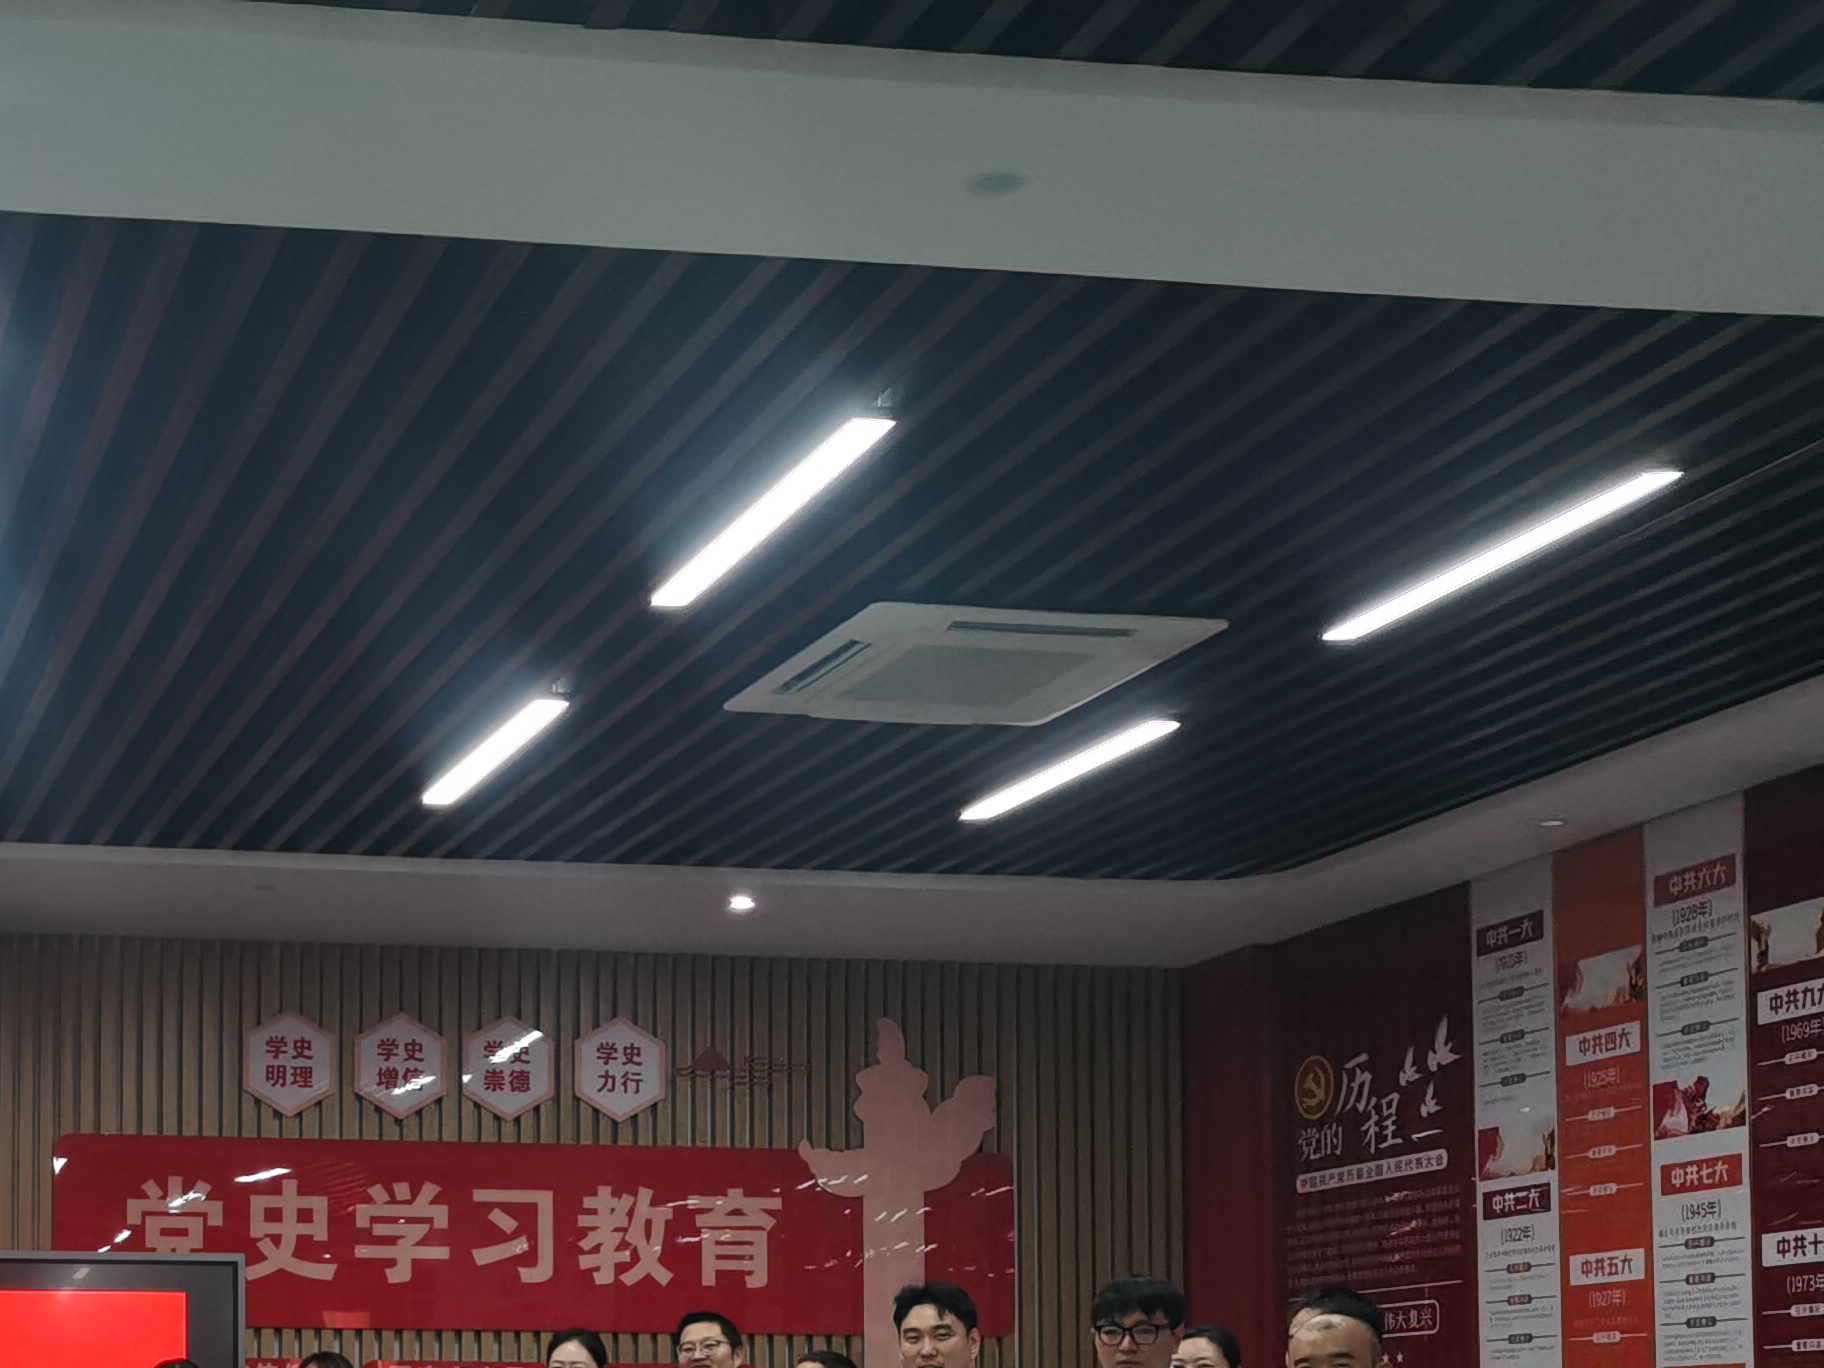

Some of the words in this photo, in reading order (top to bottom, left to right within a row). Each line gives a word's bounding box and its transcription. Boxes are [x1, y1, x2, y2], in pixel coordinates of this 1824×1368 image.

[1485, 917, 1533, 949] 中共一大
[264, 1035, 314, 1061] 学史
[376, 1037, 425, 1063] 学史
[482, 1040, 532, 1064] 学史
[595, 1041, 644, 1066] 学史
[1577, 1027, 1632, 1058] 中共四大
[264, 1065, 314, 1089] 明理
[376, 1068, 425, 1093] 增信
[482, 1070, 532, 1094] 崇德
[596, 1070, 644, 1094] 力行
[1297, 1123, 1344, 1162] 党的
[1670, 1160, 1729, 1188] 中共七大
[1492, 1187, 1540, 1214] 中共二大
[125, 1174, 784, 1289] 党史学习教育
[1580, 1253, 1633, 1279] 中共五大
